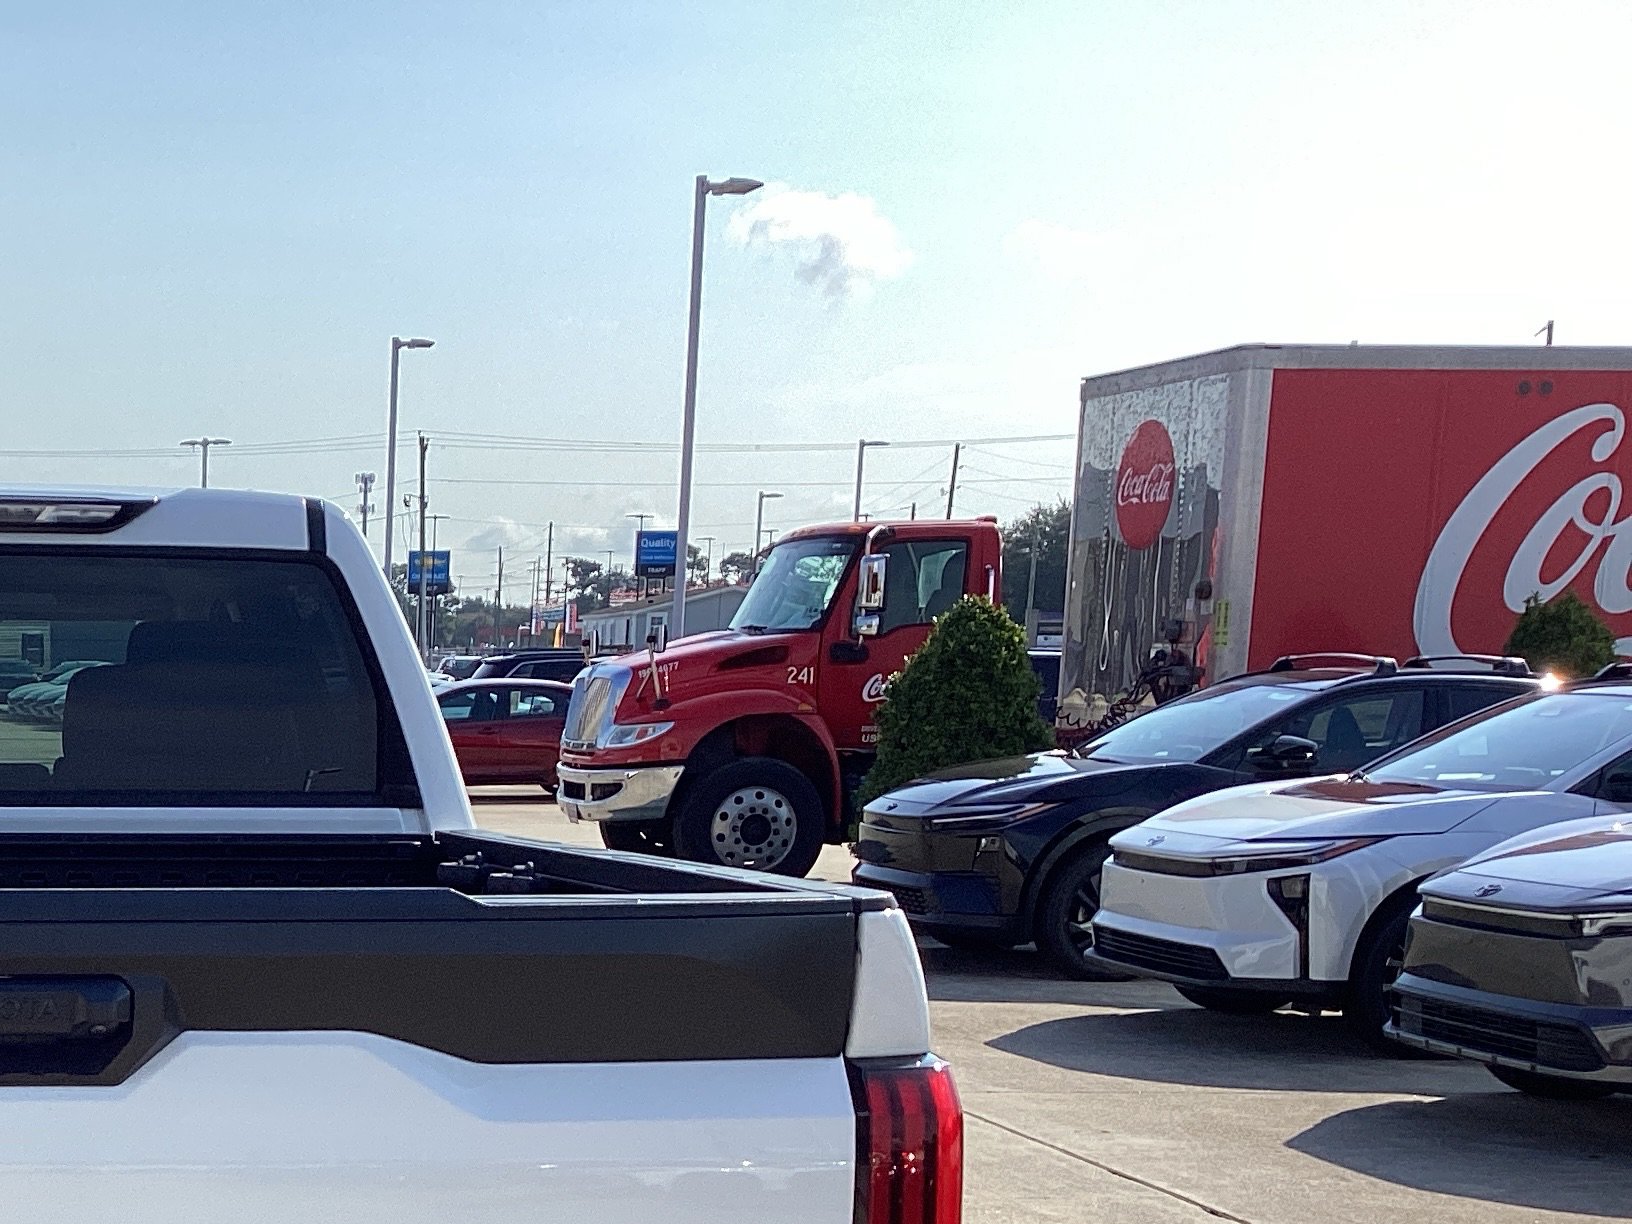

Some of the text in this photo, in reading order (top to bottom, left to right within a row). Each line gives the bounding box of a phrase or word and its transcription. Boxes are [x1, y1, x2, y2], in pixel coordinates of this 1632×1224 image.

[640, 537, 676, 550] Quality
[787, 666, 814, 685] 241
[862, 673, 890, 702] Co
